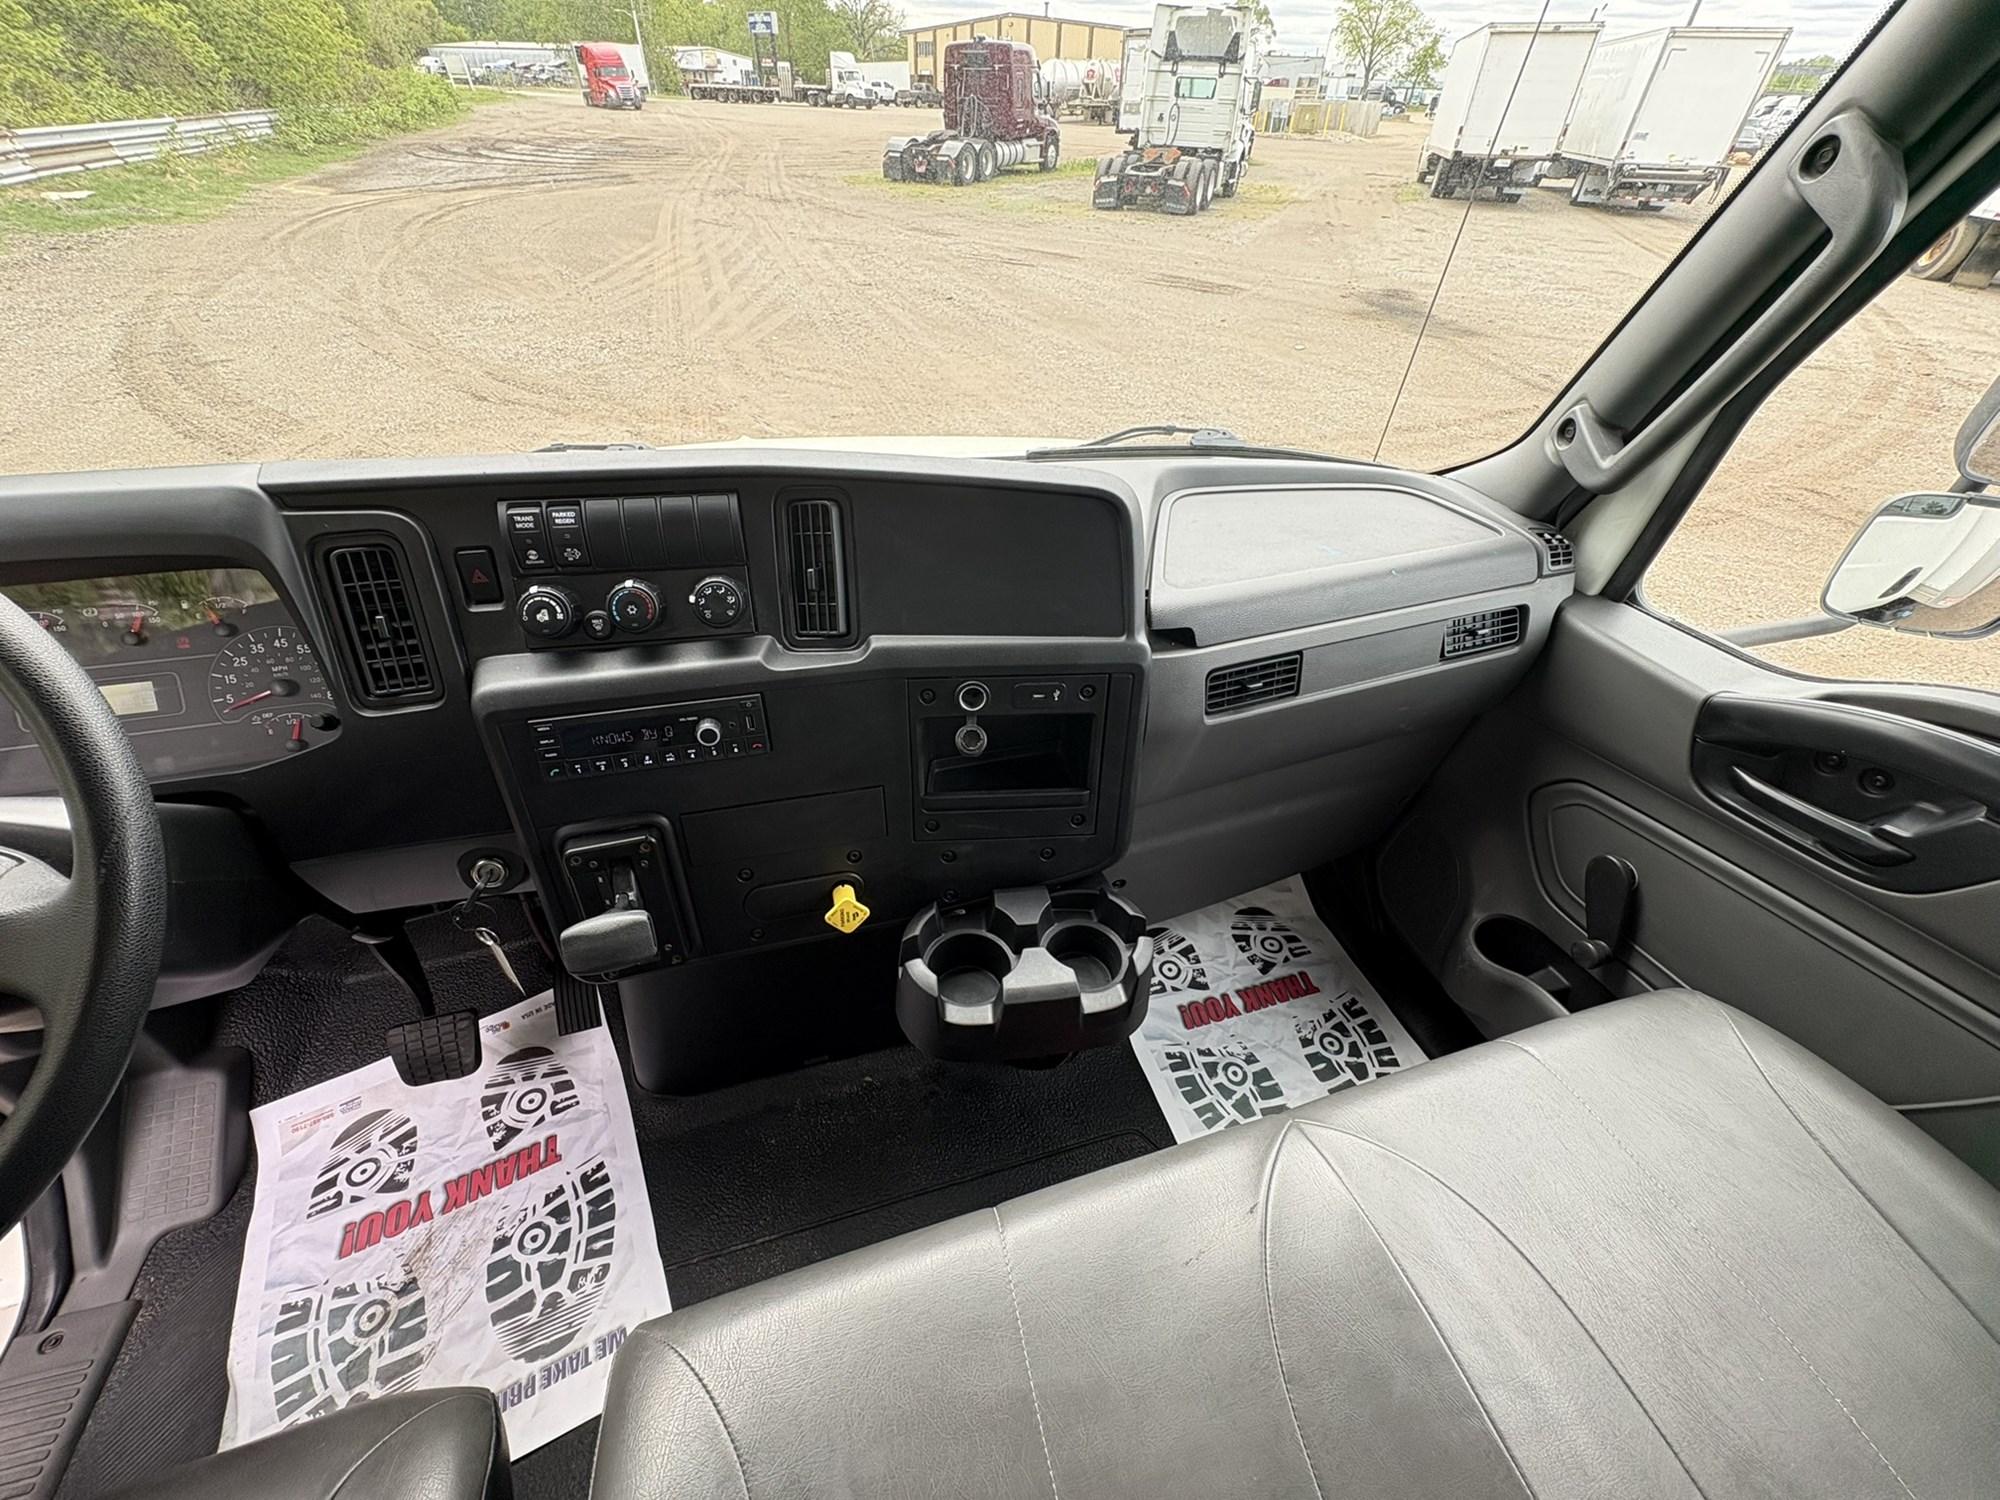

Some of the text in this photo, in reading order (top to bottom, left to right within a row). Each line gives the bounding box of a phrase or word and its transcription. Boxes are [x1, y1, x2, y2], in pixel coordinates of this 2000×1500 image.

[249, 643, 265, 655] 35
[273, 638, 289, 649] 45
[296, 644, 312, 655] 55
[232, 656, 249, 667] 25
[224, 674, 238, 685] 15
[226, 693, 235, 704] 5
[1177, 970, 1321, 1030] THANK YOU!
[338, 1134, 562, 1260] THANK YOU!
[498, 1325, 628, 1413] WE TAKE PRI
